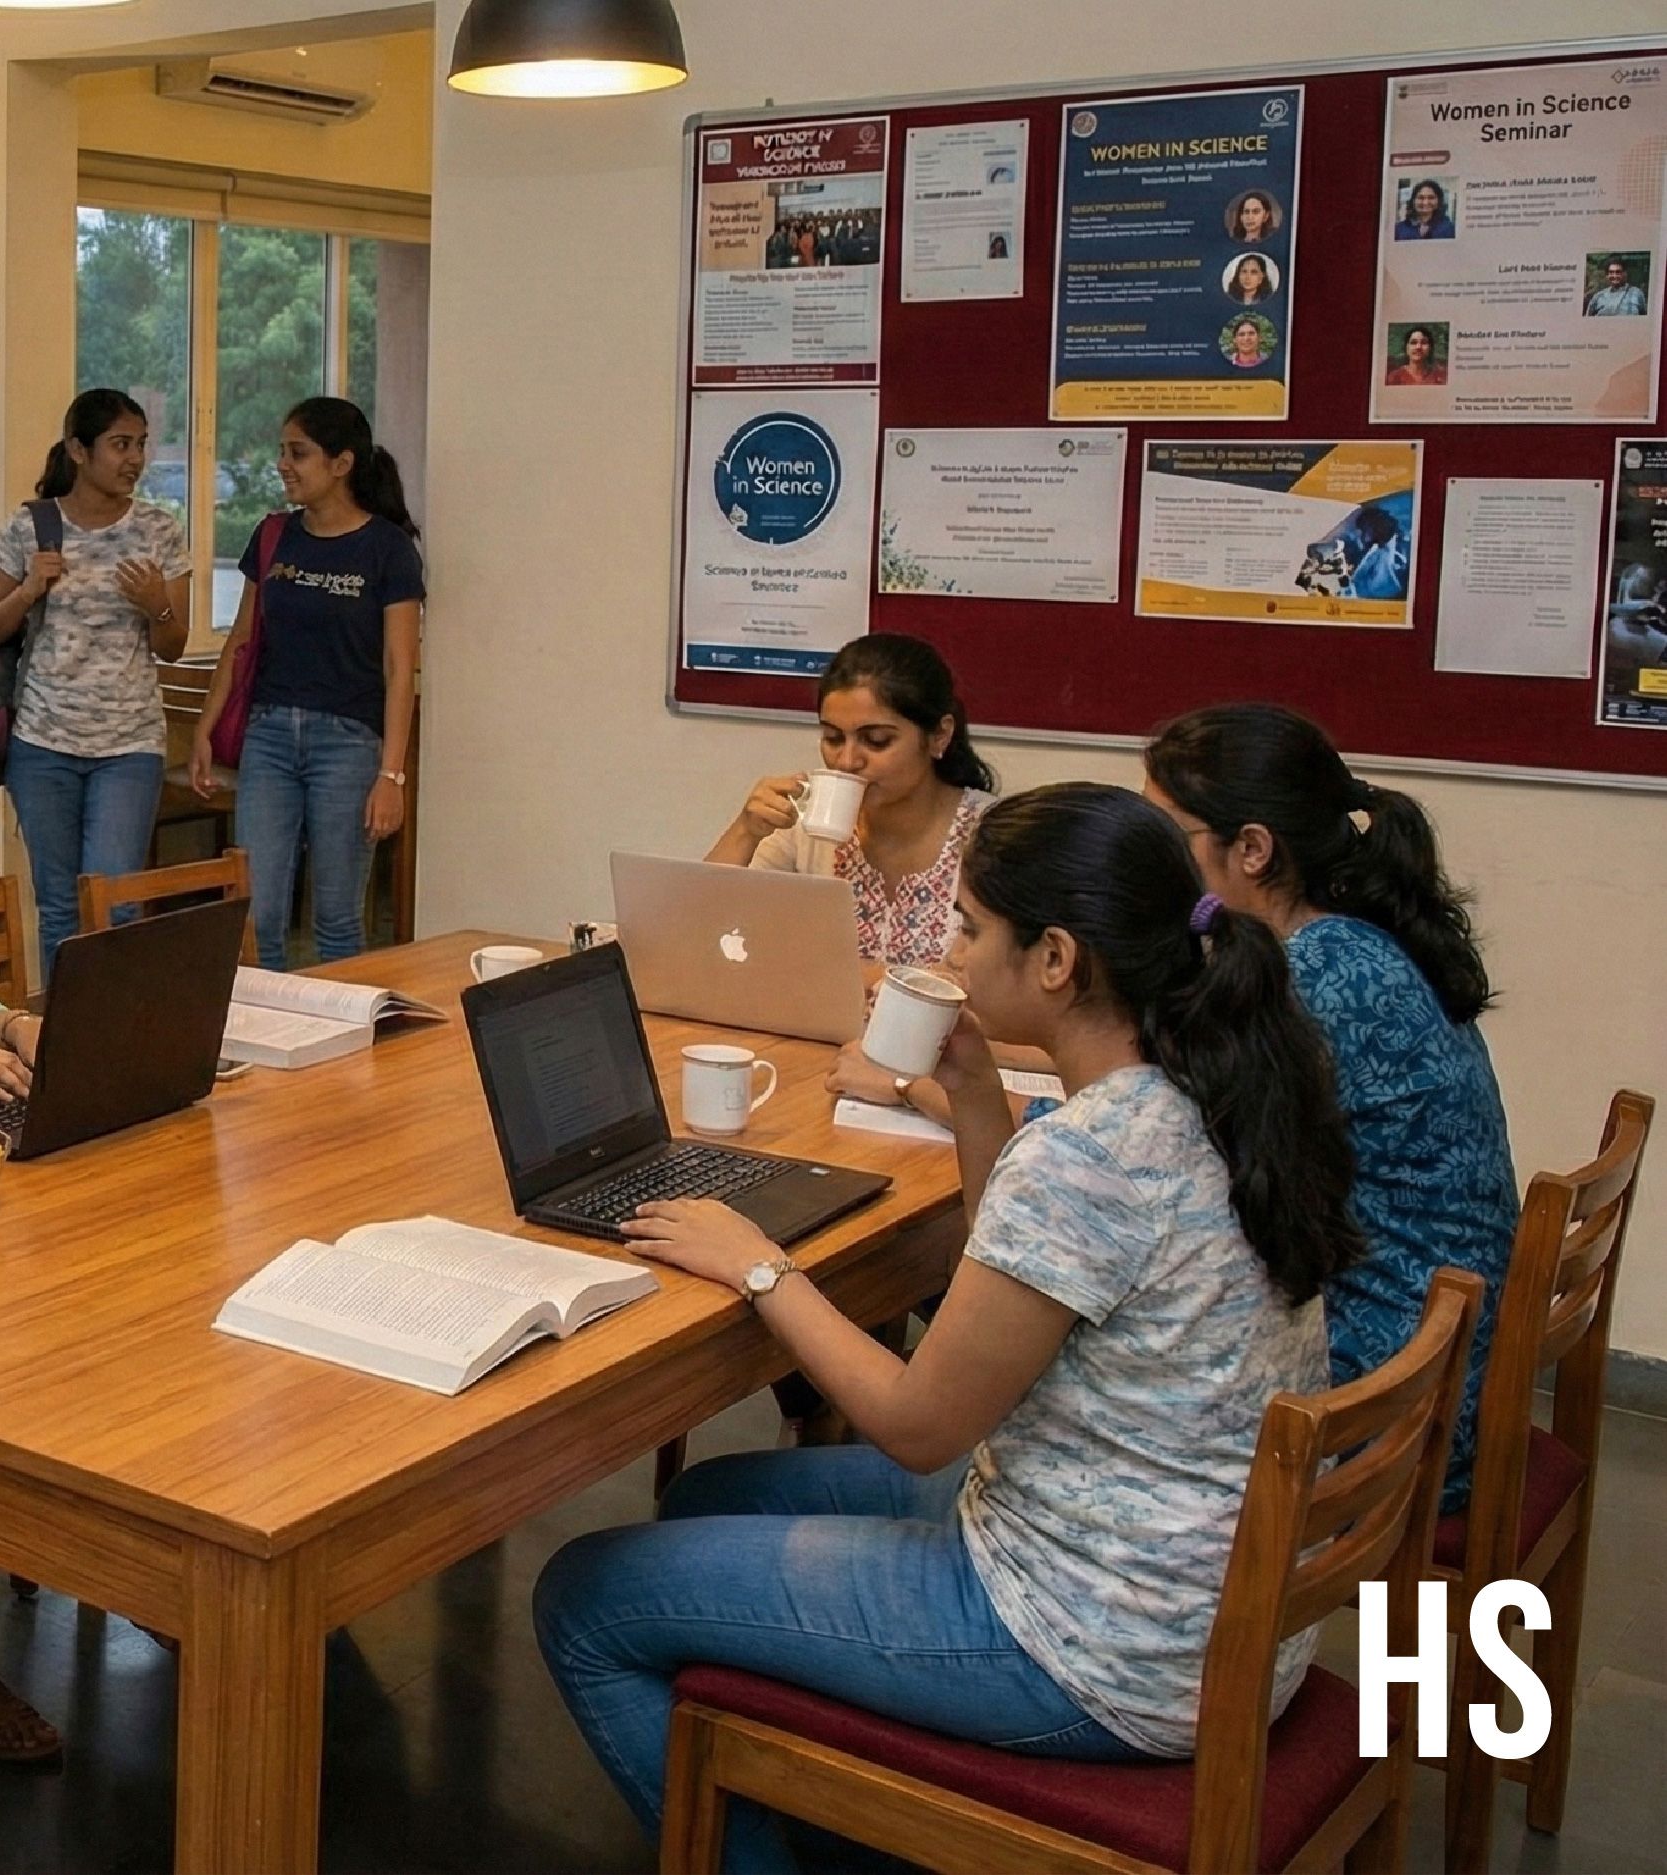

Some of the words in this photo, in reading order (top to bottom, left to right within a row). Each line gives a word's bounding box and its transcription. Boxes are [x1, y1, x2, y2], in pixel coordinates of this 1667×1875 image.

[1431, 102, 1510, 122] Women
[1516, 98, 1535, 117] in
[1542, 94, 1632, 115] Science
[1481, 122, 1573, 143] Seminar
[1091, 143, 1161, 162] WOMEN
[1166, 142, 1184, 157] IN
[1189, 135, 1269, 156] SCIENCE
[746, 456, 816, 475] Women
[732, 475, 749, 494] in
[754, 475, 824, 495] Science
